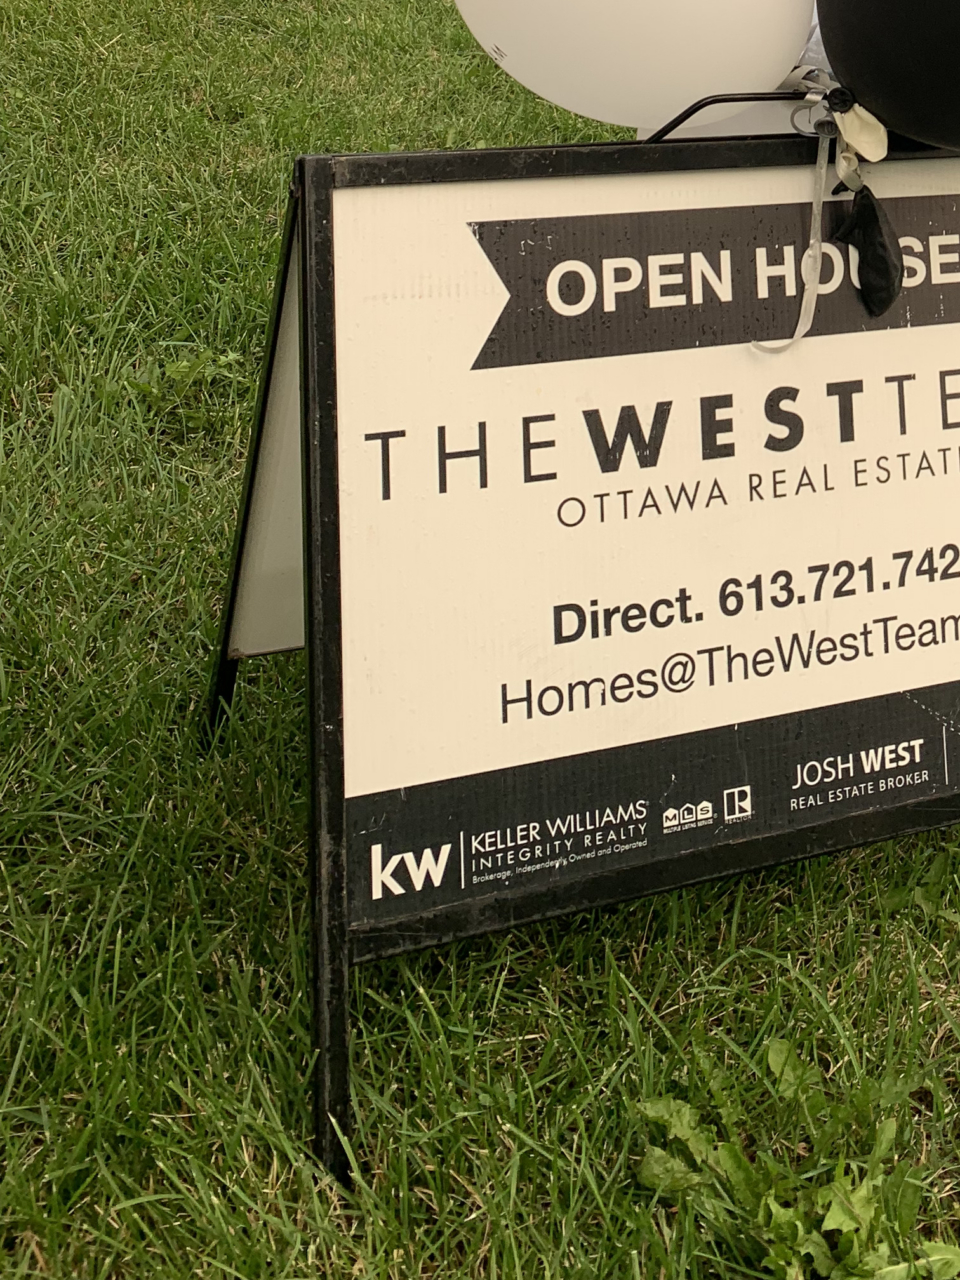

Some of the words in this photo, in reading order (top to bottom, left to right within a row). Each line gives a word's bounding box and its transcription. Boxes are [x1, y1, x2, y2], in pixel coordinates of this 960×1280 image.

[546, 249, 733, 317] OPEN
[557, 477, 728, 528] OTTAWA
[748, 463, 835, 503] REAL
[553, 588, 703, 645] Direct.
[790, 794, 824, 811] REAL
[828, 782, 874, 803] ESTATE
[879, 770, 929, 792] BROKER
[791, 753, 854, 790] JOSH
[860, 739, 924, 774] WEST
[471, 822, 542, 855] KELLER
[545, 800, 647, 837] WILLIAMS
[664, 803, 711, 825] MLS
[371, 843, 451, 901] kw
[472, 838, 574, 872] INTEGRITY
[584, 822, 647, 847] REALTY
[472, 871, 514, 884] Brokerage,
[568, 851, 596, 863] Owned
[597, 847, 612, 857] and
[613, 838, 648, 854] Operated
